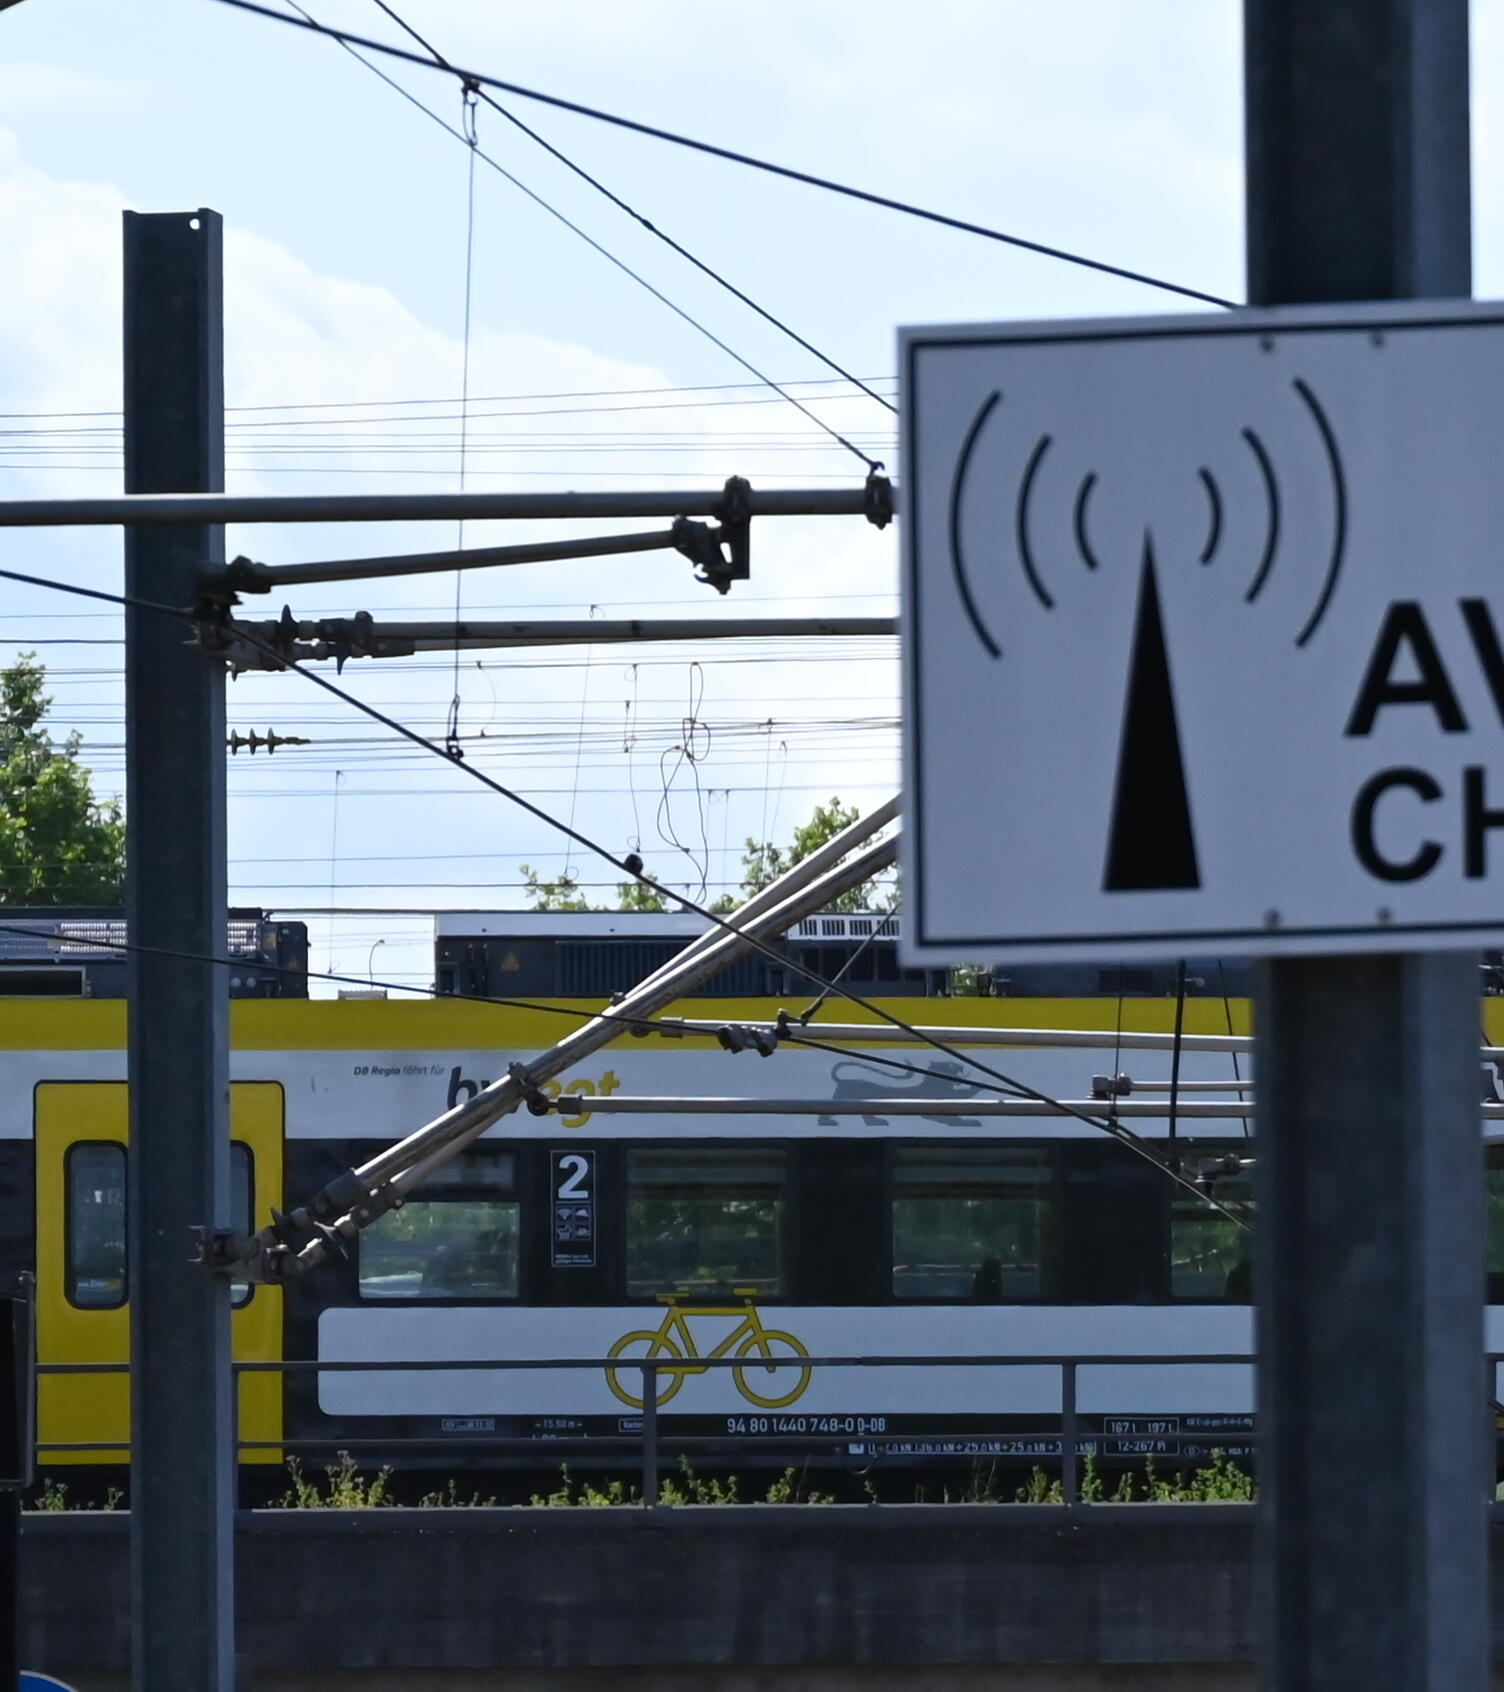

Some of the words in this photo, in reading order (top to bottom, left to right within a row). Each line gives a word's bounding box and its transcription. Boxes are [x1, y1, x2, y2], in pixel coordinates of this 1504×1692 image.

[354, 1066, 369, 1076] DB
[371, 1066, 401, 1077] Regio
[558, 1155, 589, 1198] 2
[727, 1418, 746, 1433] 94
[750, 1418, 767, 1433] 80
[772, 1418, 806, 1433] 1440
[810, 1418, 854, 1433] 748-0
[857, 1418, 885, 1435] D-DB
[1111, 1422, 1130, 1433] 167
[1148, 1422, 1166, 1433] 197
